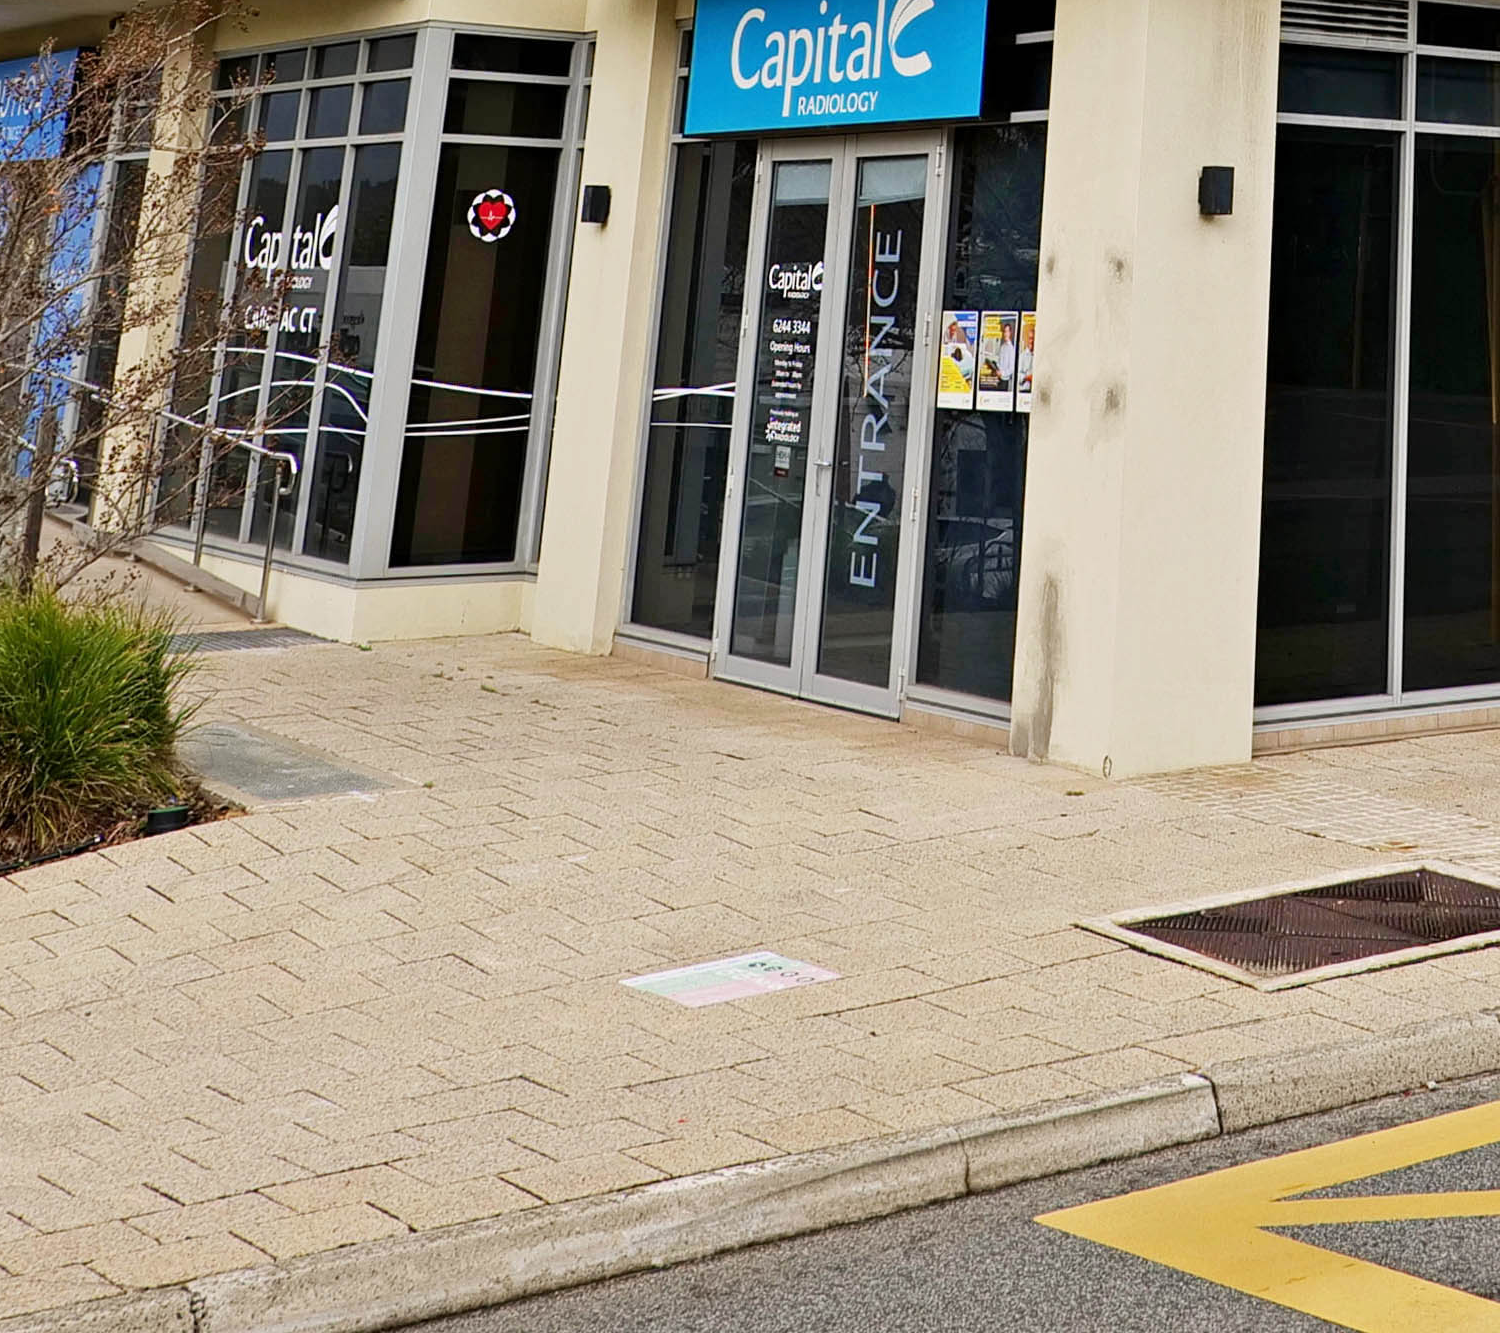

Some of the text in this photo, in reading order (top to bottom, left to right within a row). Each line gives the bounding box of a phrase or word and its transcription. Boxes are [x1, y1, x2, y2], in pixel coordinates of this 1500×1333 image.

[798, 91, 879, 116] RADIOLOGY
[244, 213, 322, 288] Captal
[769, 263, 812, 298] Capital
[301, 307, 317, 333] CT
[849, 229, 902, 588] ENTRANCE
